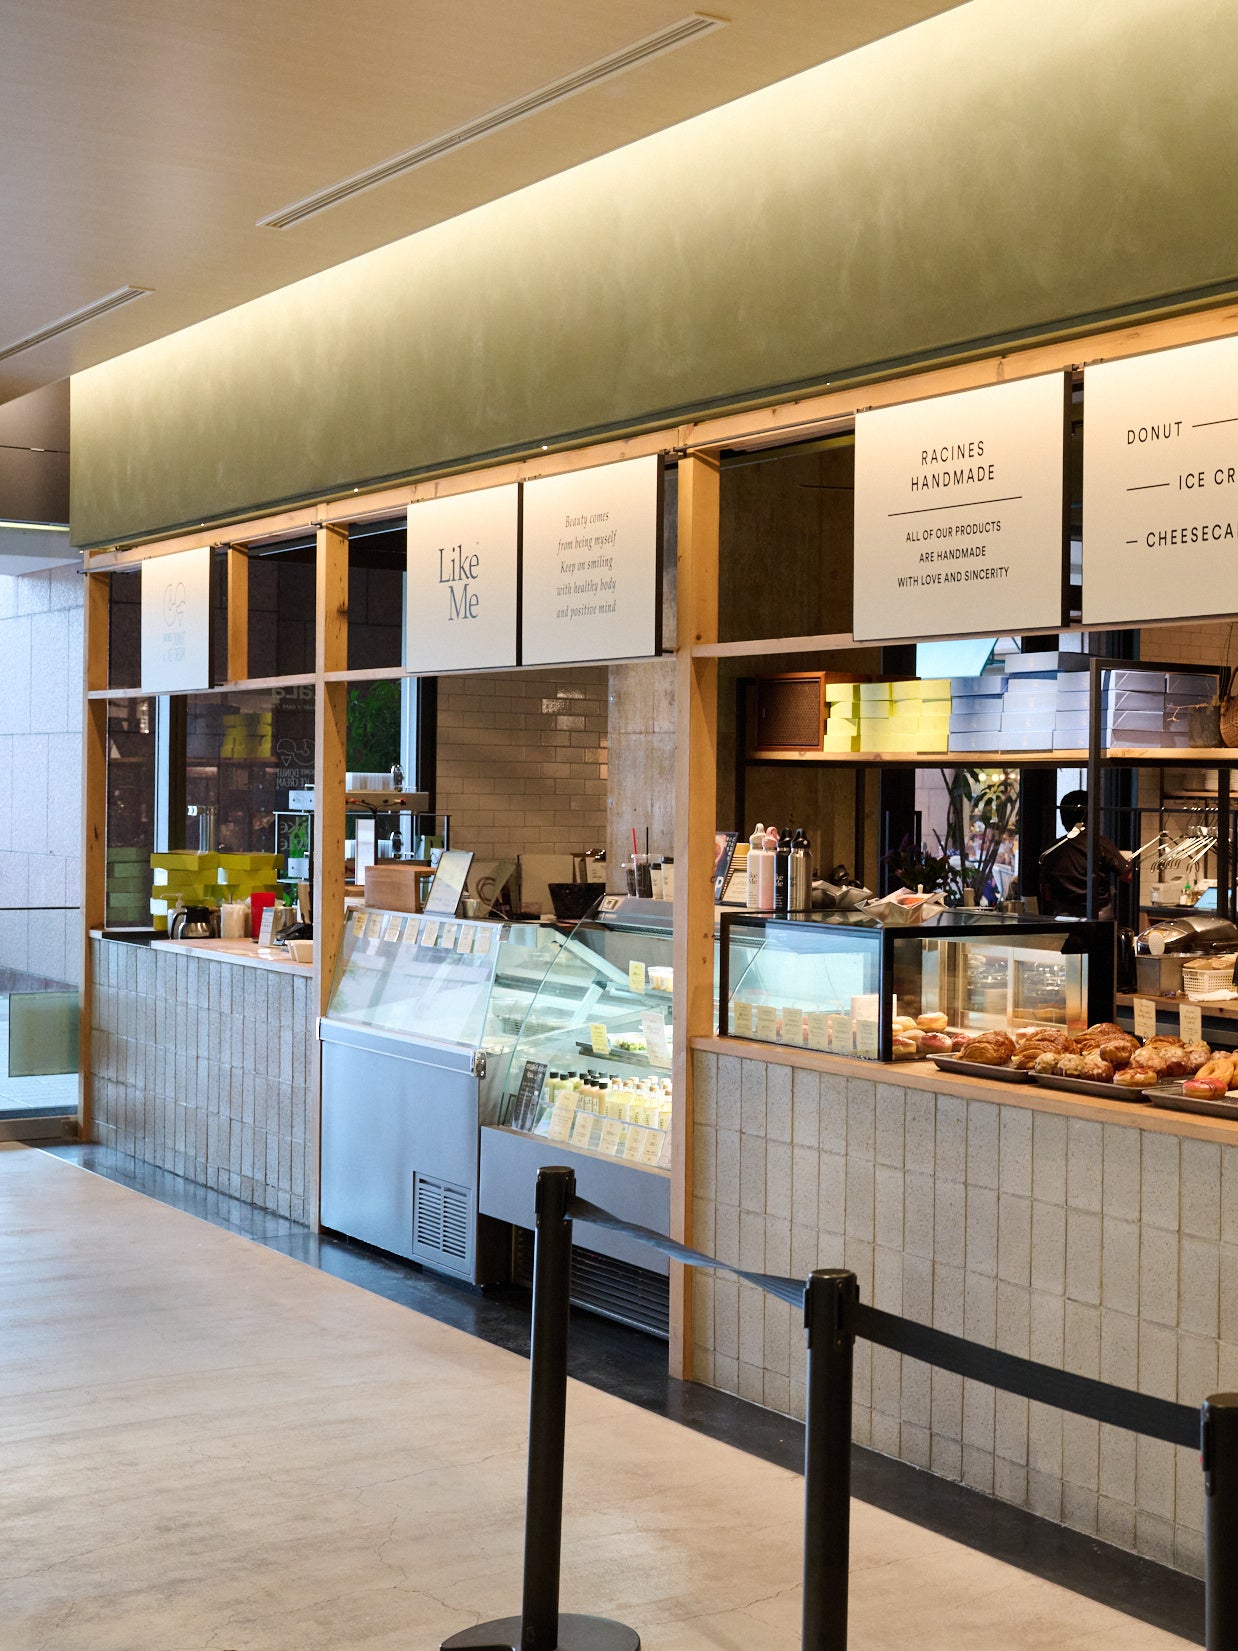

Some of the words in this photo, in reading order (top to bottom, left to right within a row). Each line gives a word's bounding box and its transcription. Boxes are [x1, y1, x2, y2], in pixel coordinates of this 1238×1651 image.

[1128, 422, 1182, 444] DONUT
[922, 441, 984, 466] RACINES
[912, 464, 994, 491] HANDMADE
[1180, 472, 1204, 490] ICE
[565, 514, 587, 529] Beauty
[590, 512, 609, 523] comes
[906, 532, 920, 542] ALL
[923, 529, 933, 540] OF
[936, 527, 952, 538] OUR
[956, 520, 1001, 536] PRODUCTS
[557, 539, 573, 556] from
[575, 536, 592, 551] being
[594, 530, 617, 549] myself
[438, 544, 480, 583] Like
[919, 552, 934, 563] ARE
[937, 546, 986, 561] HANDMADE
[561, 561, 576, 576] Keep
[577, 562, 585, 571] on
[587, 555, 613, 571] smiling
[898, 576, 918, 587] WITH
[921, 574, 941, 585] LOVE
[944, 572, 962, 583] AND
[965, 566, 1009, 581] SINCERITY
[557, 583, 572, 598] with
[573, 580, 598, 596] healthy
[600, 577, 616, 593] body
[448, 584, 480, 621] Me
[556, 605, 569, 618] and
[570, 603, 597, 621] positive
[599, 601, 616, 613] mind
